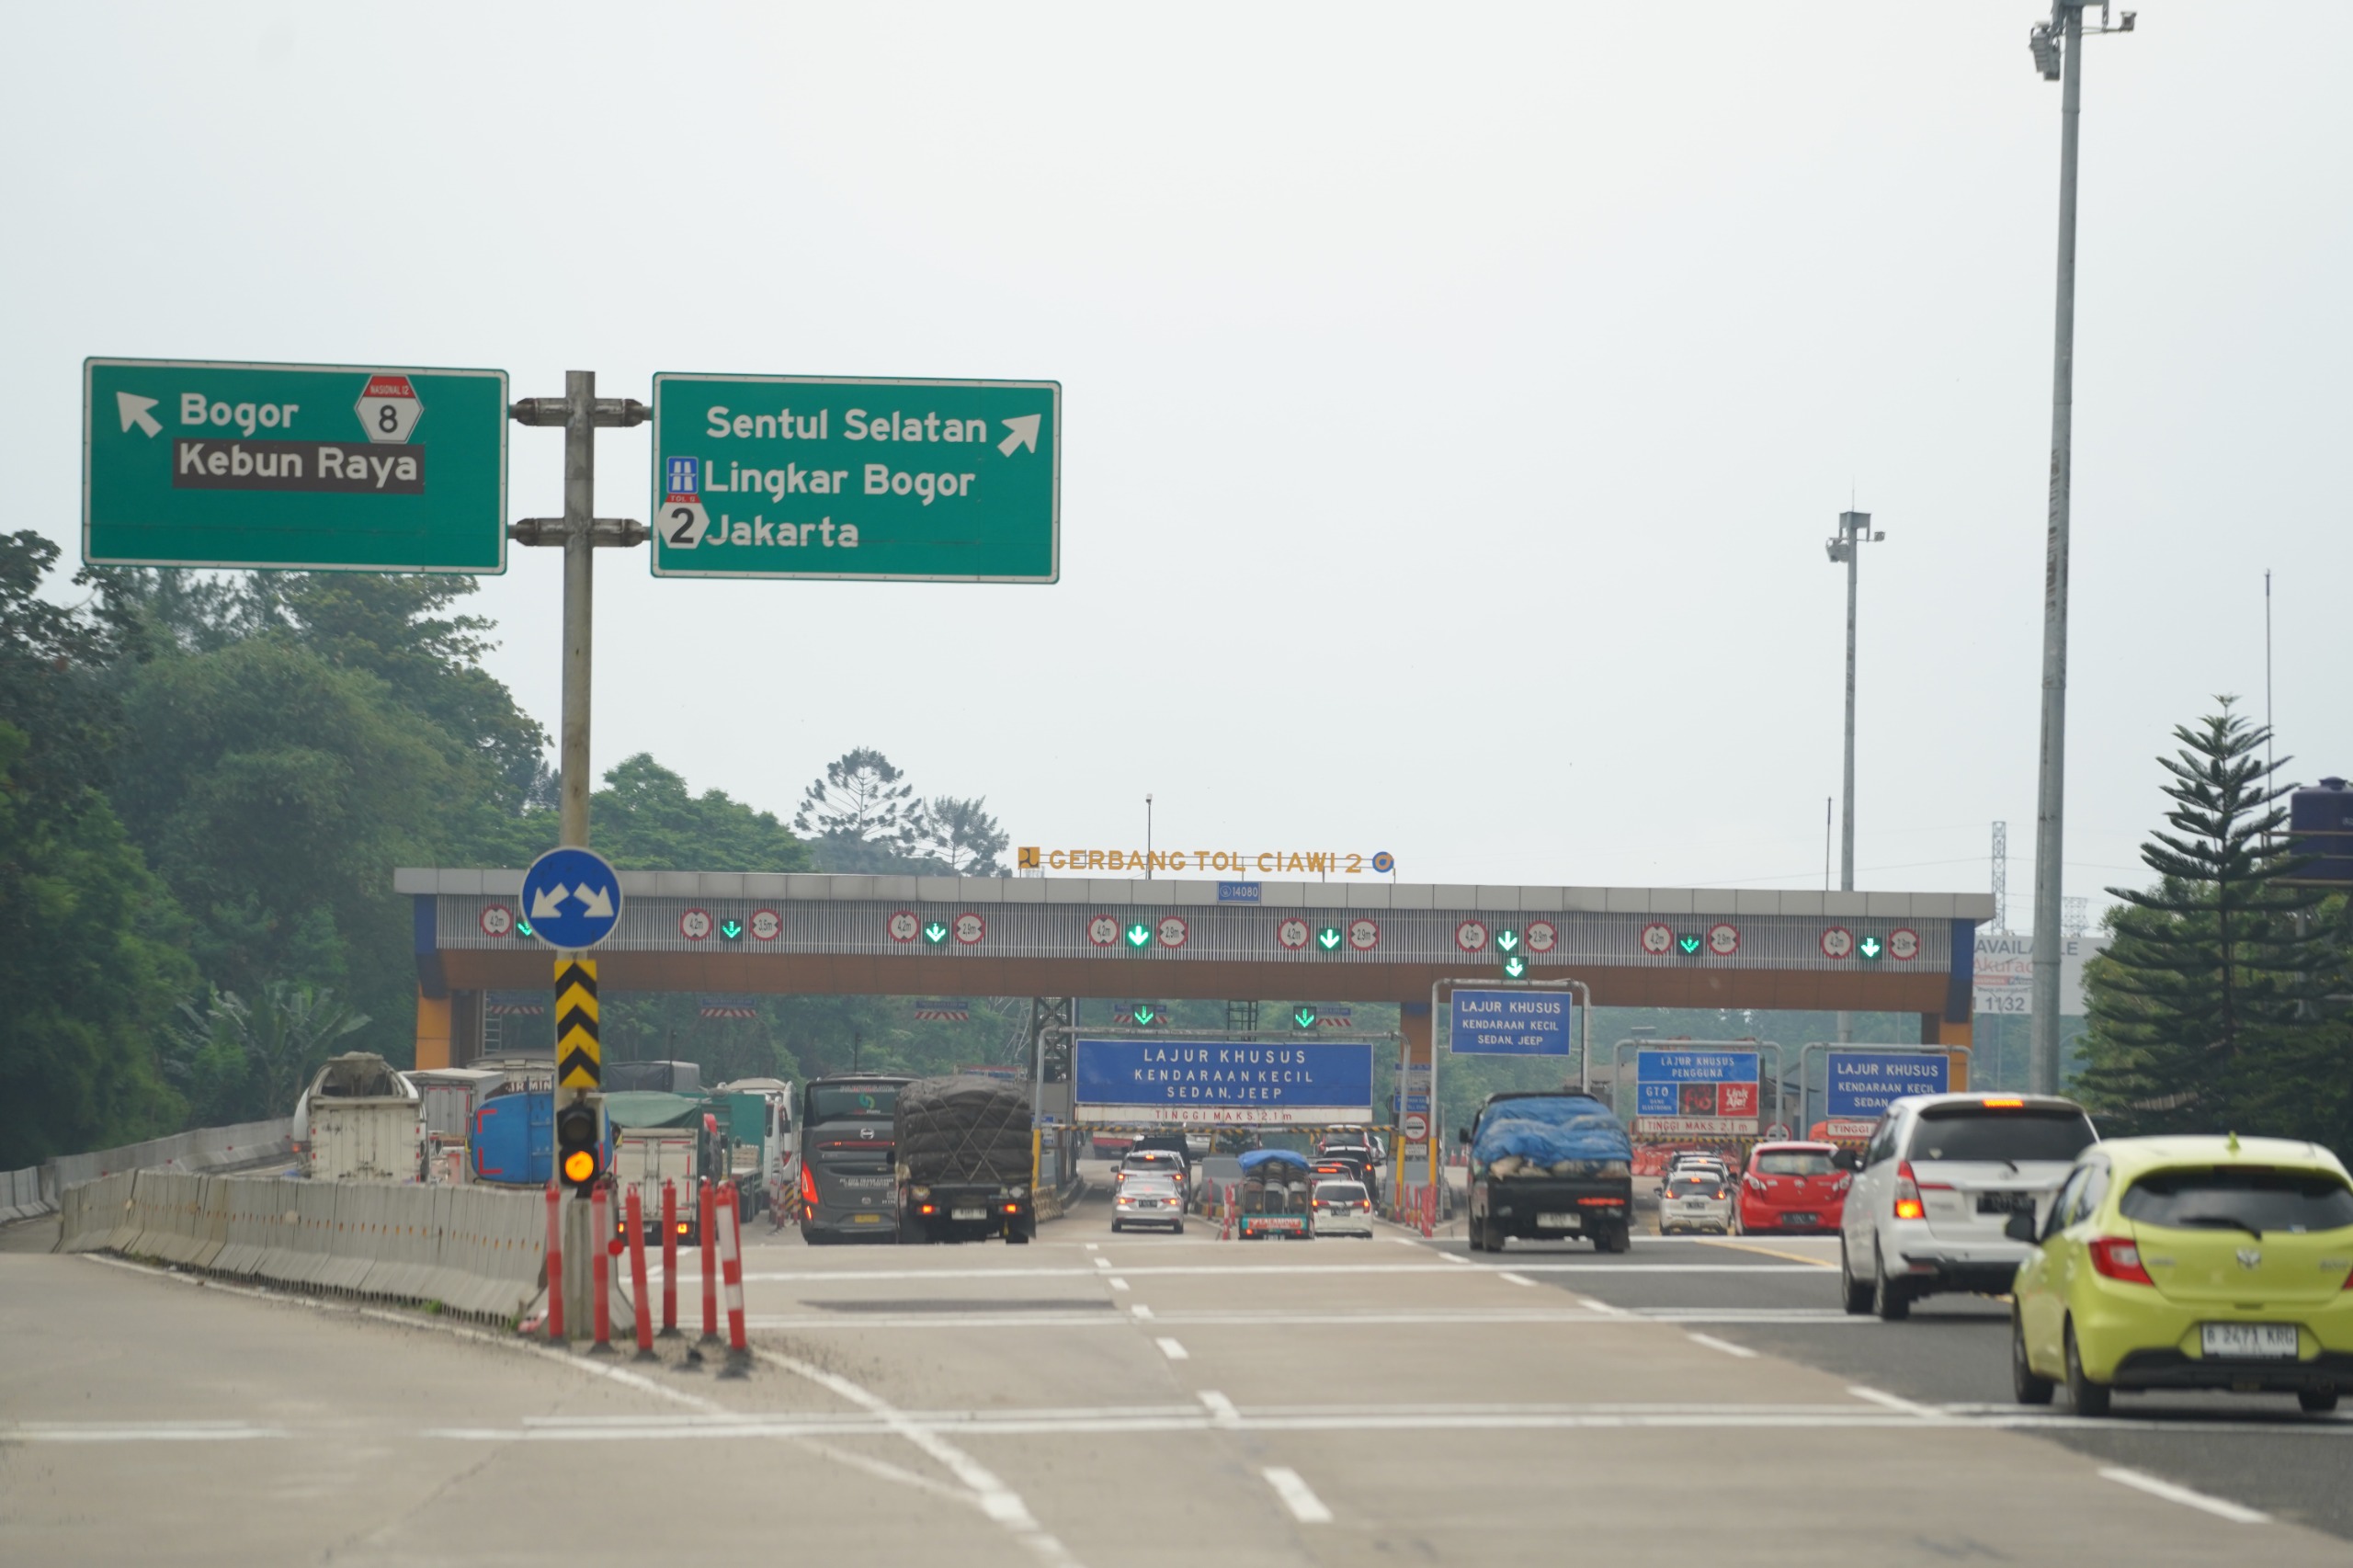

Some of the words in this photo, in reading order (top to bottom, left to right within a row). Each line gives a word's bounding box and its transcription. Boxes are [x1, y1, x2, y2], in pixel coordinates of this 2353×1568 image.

[369, 384, 401, 395] NASIONAL
[181, 392, 299, 436] Bogor
[379, 404, 398, 434] 8
[706, 405, 827, 439] Sentul
[844, 408, 987, 443] Selatan
[178, 443, 303, 478] Kebun
[318, 447, 418, 488] Raya
[705, 460, 848, 504] Lingkar
[864, 463, 976, 506] Bogor
[671, 494, 687, 503] TOL
[670, 506, 695, 544] 2
[705, 514, 859, 548] Jakarta
[1049, 849, 1186, 871] GERBANG
[1193, 851, 1246, 872] TOL
[1257, 851, 1336, 873] CIAWI
[1345, 853, 1362, 873] 2
[1232, 886, 1258, 898] 14080
[1974, 938, 2078, 956] AVAILE
[1461, 1000, 1503, 1013] LAJUR
[1509, 1001, 1562, 1015] KHUSUS
[1462, 1018, 1525, 1031] KENDARAAN
[1529, 1020, 1559, 1031] KECIL
[1518, 1035, 1544, 1046] JEEP
[1143, 1048, 1209, 1063] LAJUR
[1220, 1049, 1306, 1064] KHUSUS
[1660, 1056, 1691, 1066] LAJUR
[1696, 1056, 1735, 1066] KHUSUS
[1134, 1069, 1250, 1083] KENDARAAN
[1258, 1070, 1313, 1084] KECIL
[1672, 1068, 1723, 1078] PENGGUNA
[1837, 1062, 1880, 1075] LAJUR
[1886, 1063, 1939, 1078] KHUSUS
[1237, 1087, 1283, 1100] JEEP
[1645, 1085, 1669, 1097] GTO
[1725, 1087, 1749, 1099] Link
[1838, 1081, 1902, 1094] KENDARAAN
[1907, 1083, 1937, 1094] KECIL
[1854, 1096, 1889, 1108] SEDAN
[1155, 1108, 1207, 1121] TINGGI
[1282, 1112, 1292, 1121] m
[1647, 1120, 1679, 1131] TINGGI
[1738, 1123, 1748, 1131] m
[1833, 1124, 1870, 1134] TINGGI
